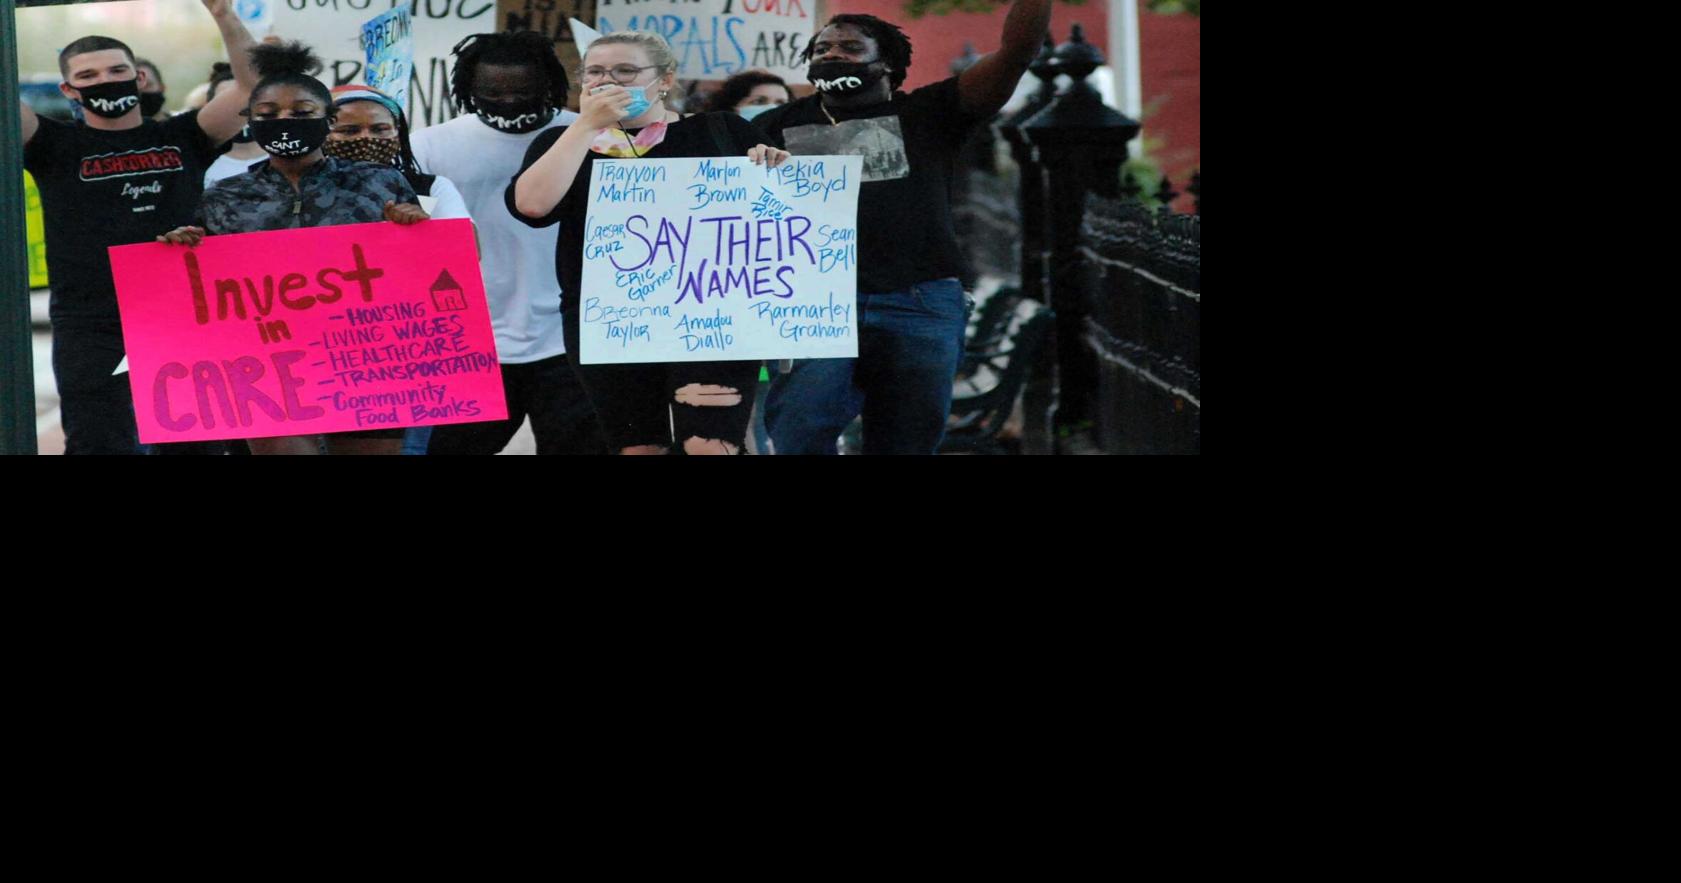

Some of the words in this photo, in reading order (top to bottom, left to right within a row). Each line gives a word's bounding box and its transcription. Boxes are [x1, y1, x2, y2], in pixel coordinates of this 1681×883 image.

[281, 132, 289, 140] I
[693, 159, 741, 185] Marlon
[783, 164, 847, 202] Boyd
[596, 183, 656, 203] Martin
[686, 183, 747, 210] Brown
[758, 185, 793, 213] Tamir
[814, 224, 856, 248] Sean
[608, 214, 693, 290] SAY
[699, 214, 817, 267] THEIR
[817, 243, 856, 273] Bell
[183, 243, 385, 325] Invest
[674, 257, 795, 305] NAMES
[253, 316, 292, 345] in
[392, 314, 465, 341] WAGES
[673, 307, 733, 334] Amadou
[779, 319, 851, 342] Graham
[678, 330, 734, 351] Diallo
[153, 350, 326, 432] CARE
[355, 408, 400, 427] Food
[410, 397, 482, 423] Banks
